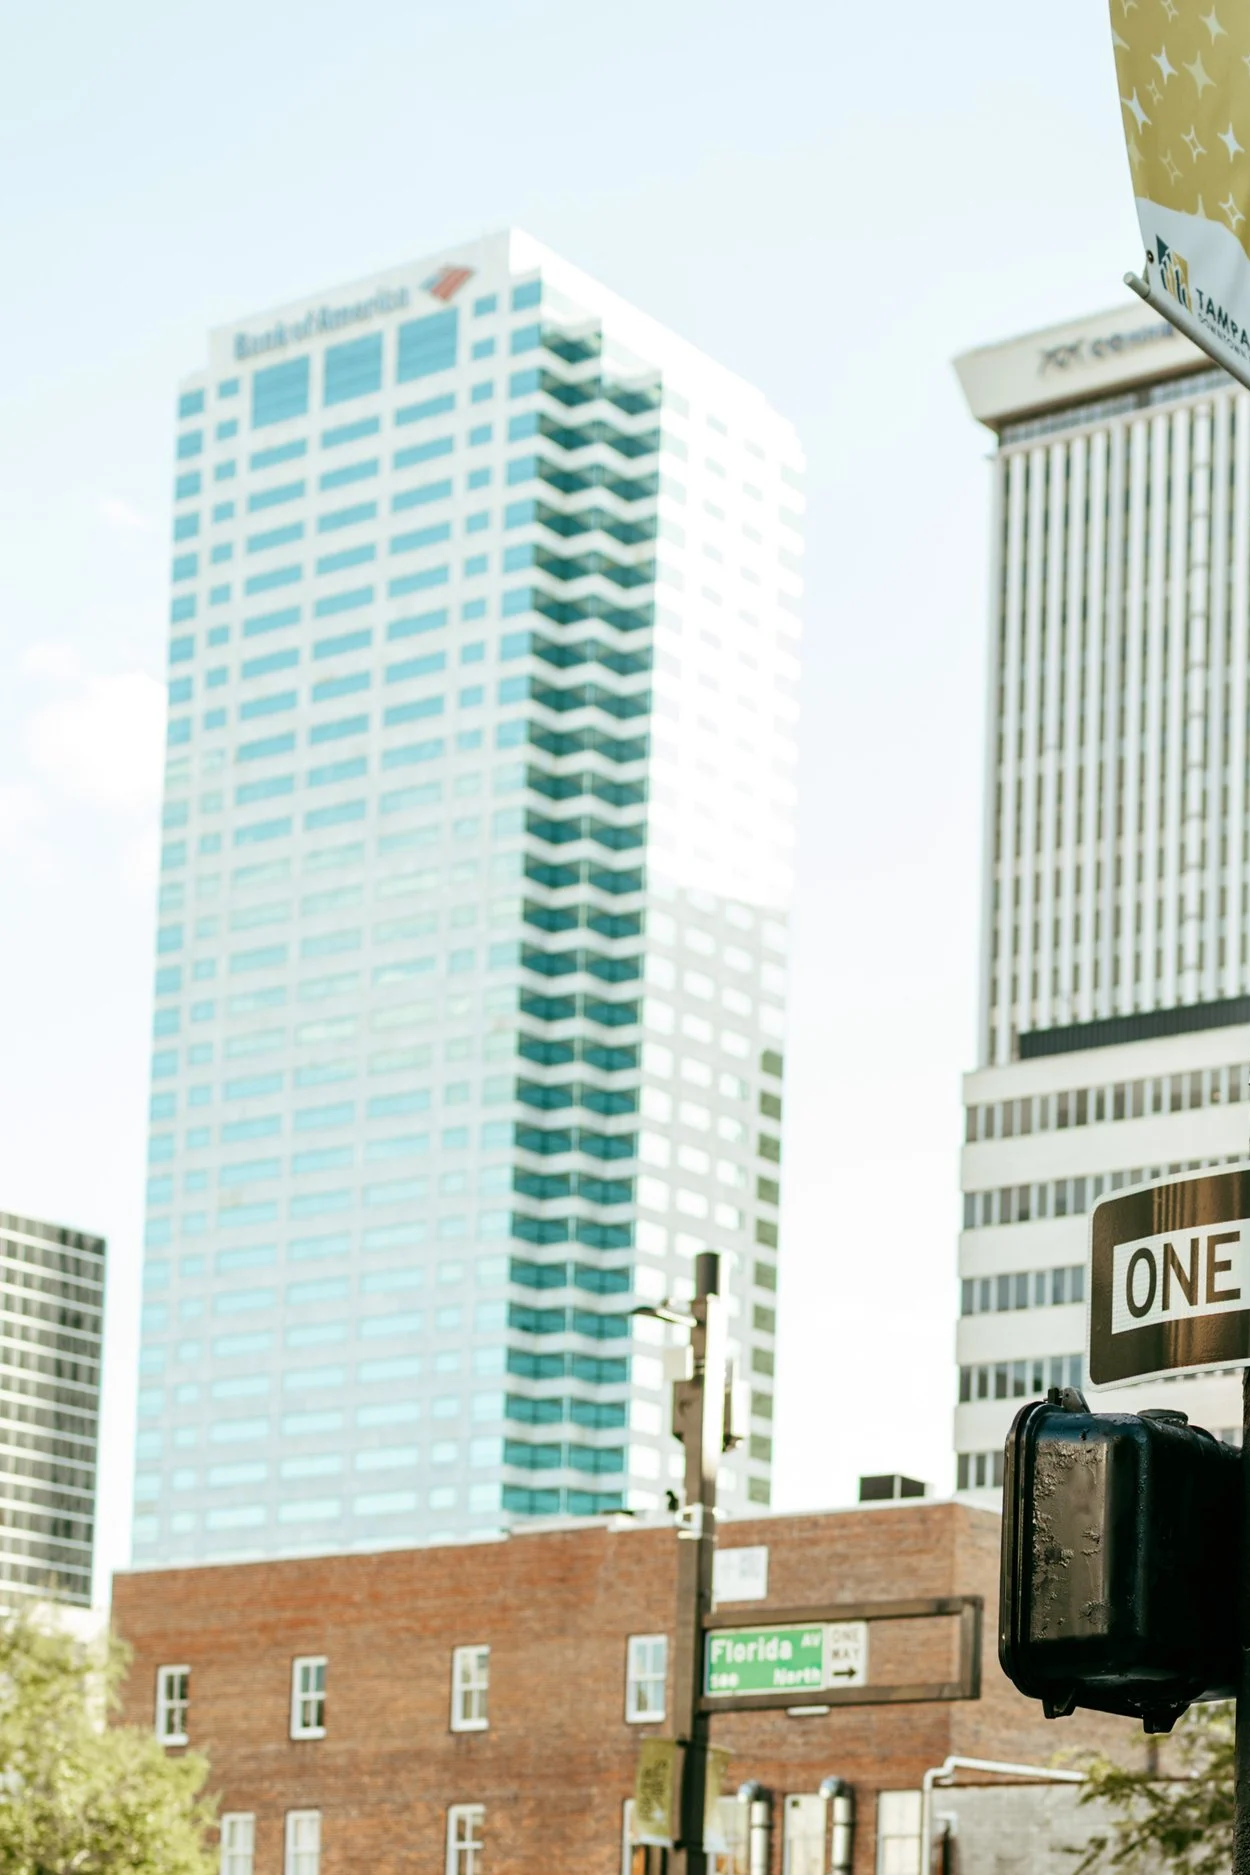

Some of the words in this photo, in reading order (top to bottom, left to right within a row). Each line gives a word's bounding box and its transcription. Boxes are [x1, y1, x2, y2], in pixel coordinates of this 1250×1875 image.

[235, 320, 287, 362] Bank
[290, 309, 315, 343] of
[316, 285, 410, 334] America
[1198, 313, 1248, 360] DOWNTOWN
[1126, 1230, 1242, 1319] ONE
[711, 1636, 794, 1665] Florida
[800, 1632, 822, 1648] AV
[832, 1628, 860, 1644] ONE
[832, 1647, 860, 1662] WAY
[773, 1665, 821, 1686] North
